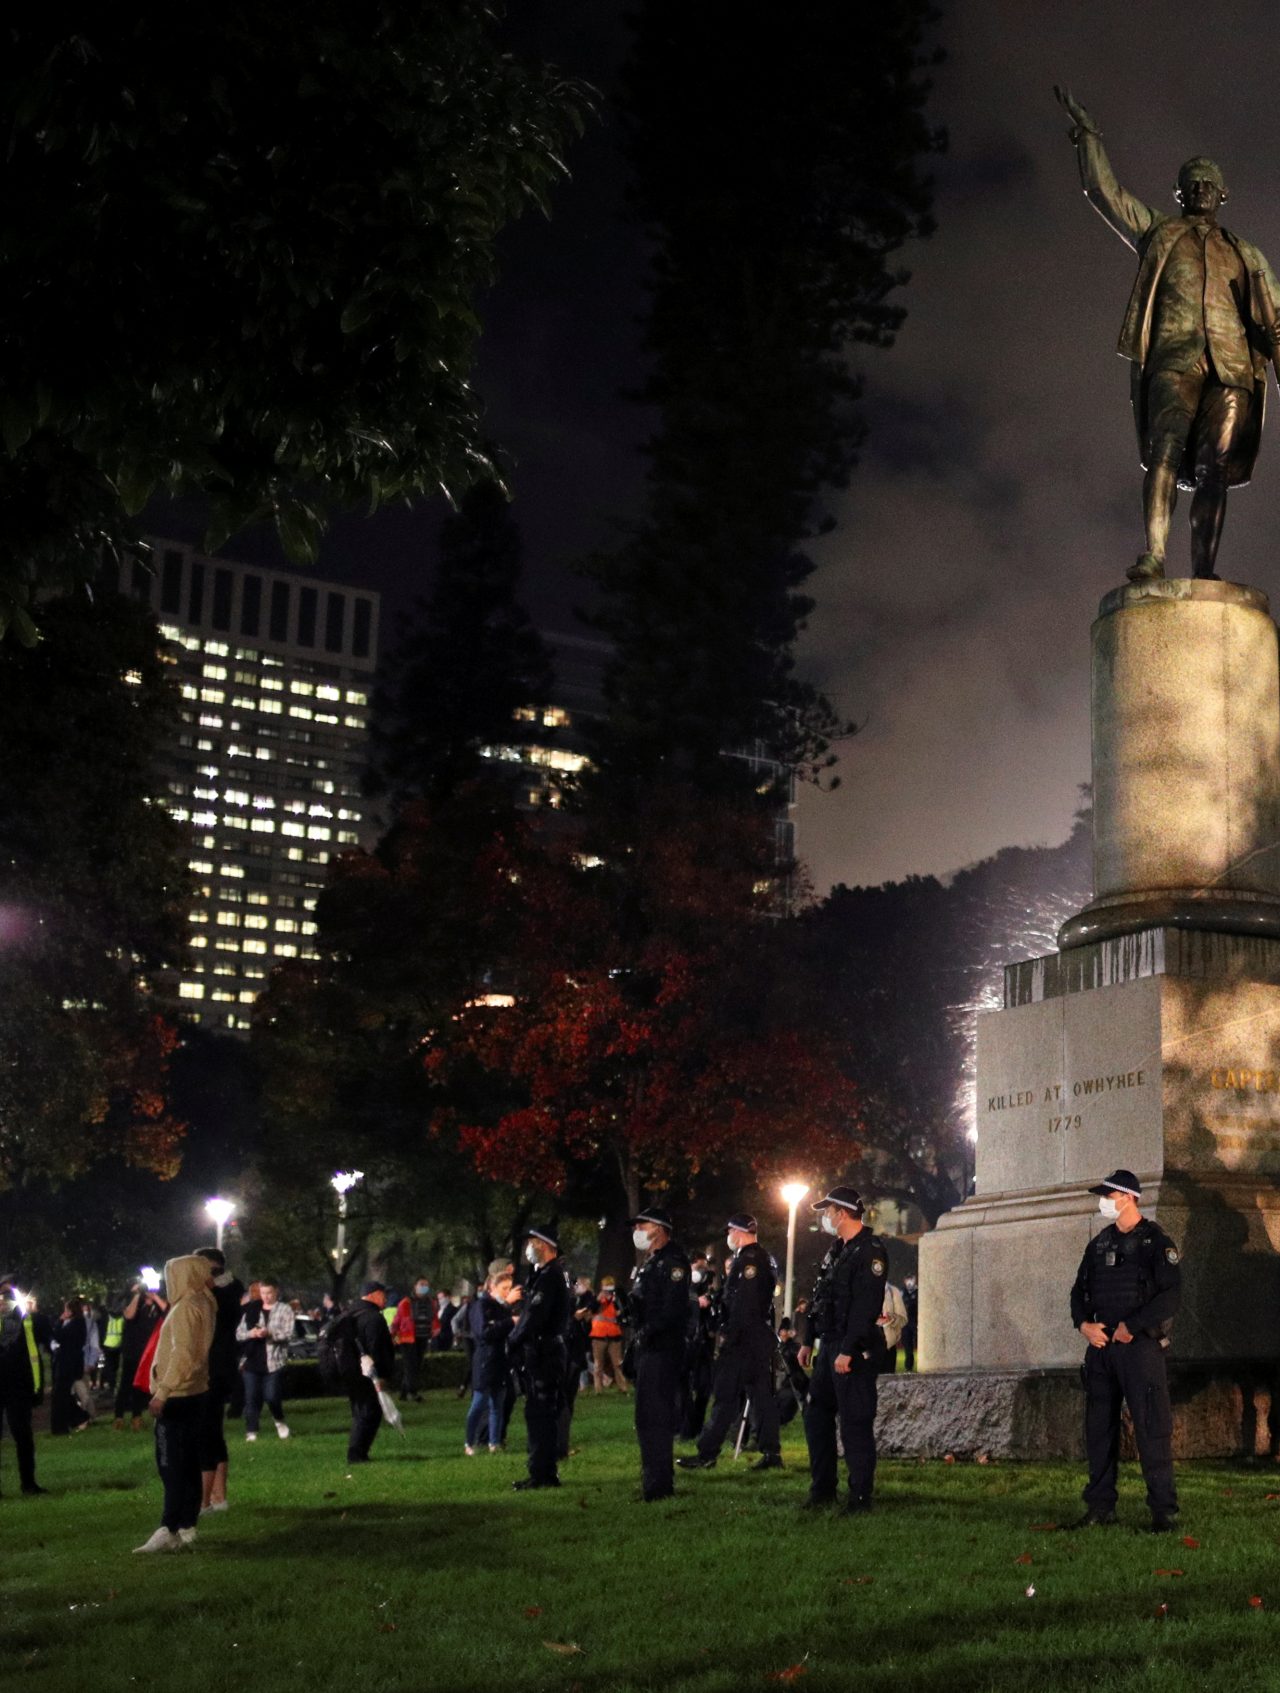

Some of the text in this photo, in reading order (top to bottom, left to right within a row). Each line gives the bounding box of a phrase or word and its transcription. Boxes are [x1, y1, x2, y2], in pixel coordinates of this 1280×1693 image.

[988, 1071, 1146, 1111] KILLED AT OWHYHEE
[1048, 1115, 1082, 1133] 1779
